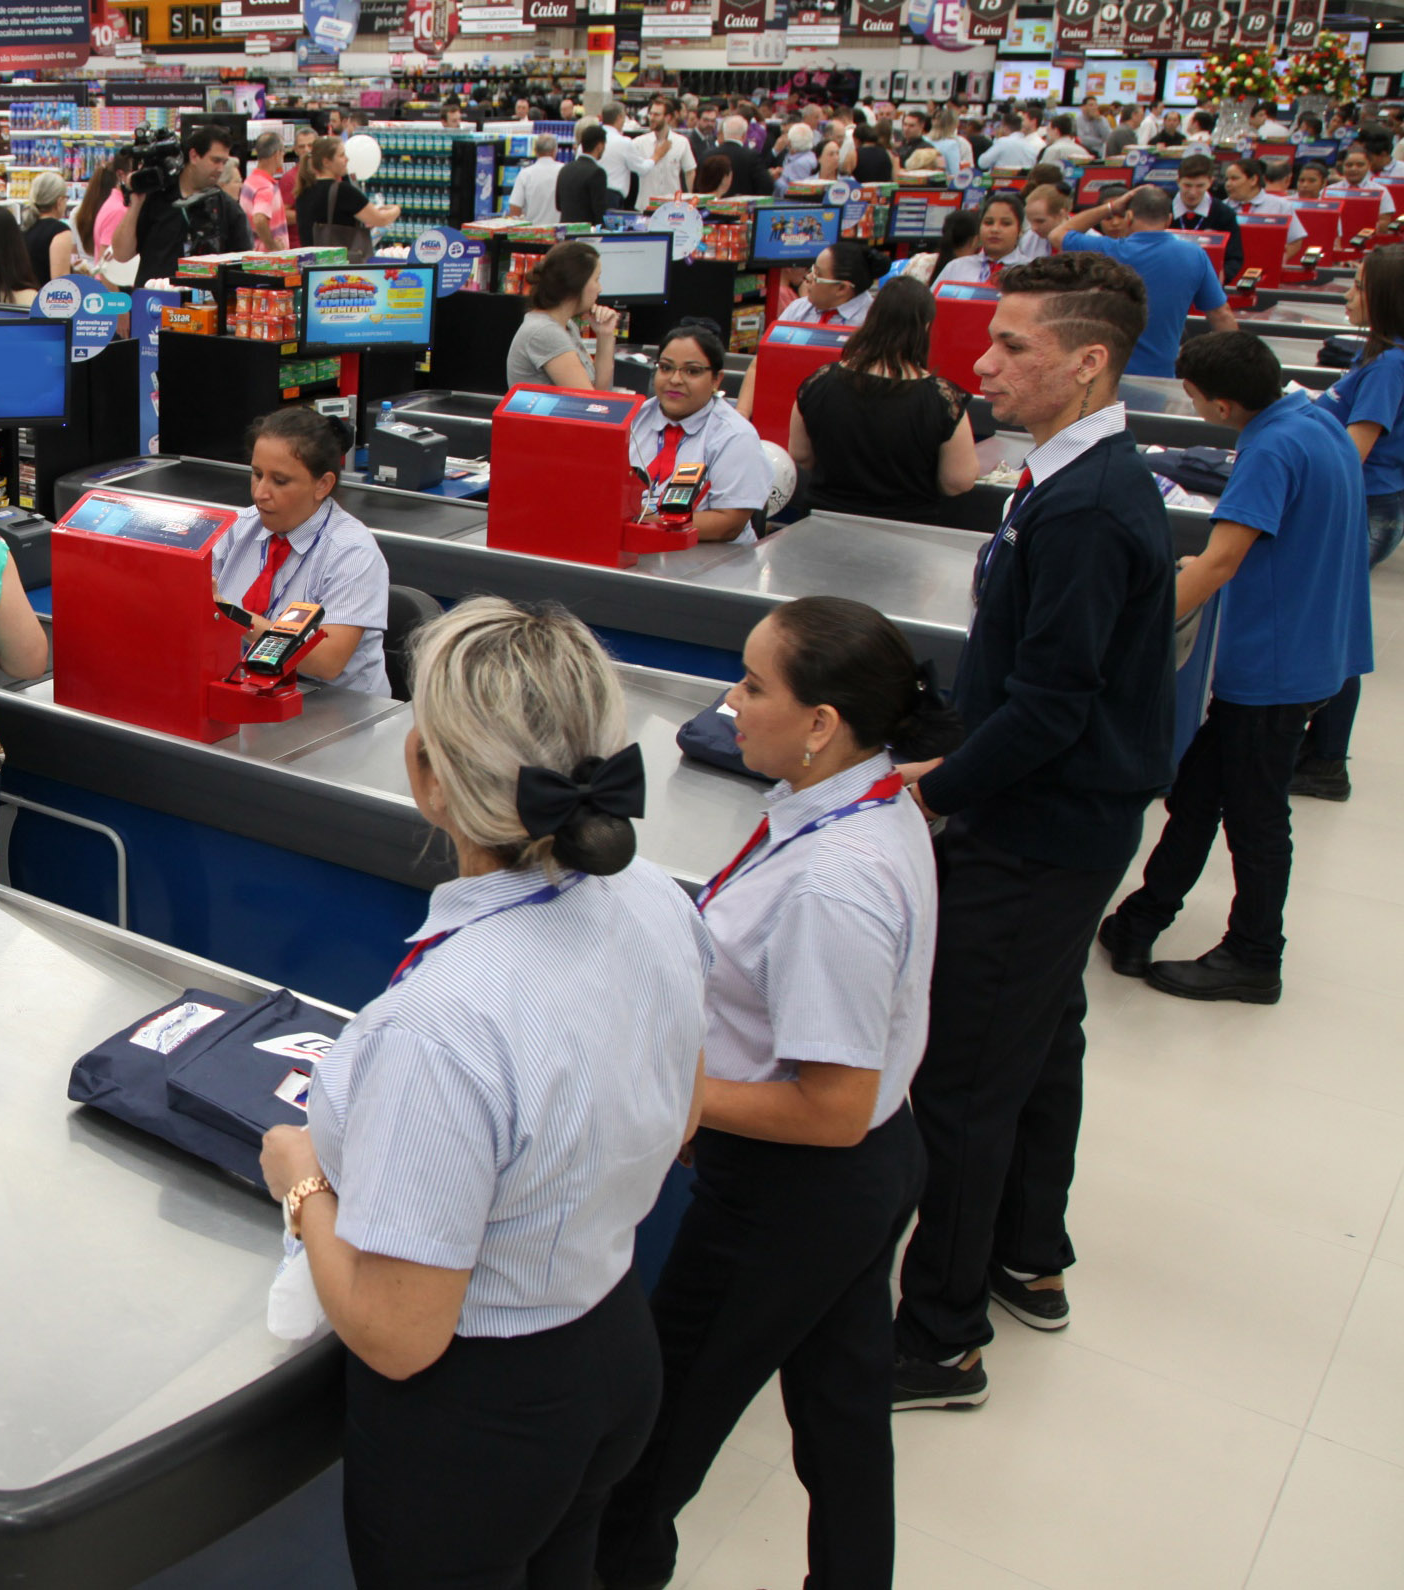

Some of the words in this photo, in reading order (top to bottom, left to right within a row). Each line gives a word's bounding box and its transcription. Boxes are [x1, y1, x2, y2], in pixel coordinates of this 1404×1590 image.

[530, 1, 568, 18] Caixa
[1066, 0, 1089, 15] 16
[1133, 4, 1156, 22] 17
[172, 14, 222, 34] Sho
[724, 14, 758, 28] Caixa
[862, 19, 894, 31] Caixa
[1190, 11, 1212, 28] 18
[1247, 15, 1266, 30] 19
[92, 25, 119, 47] 10x
[974, 24, 1002, 36] Caixa
[1061, 27, 1088, 39] Caixa
[1292, 22, 1314, 36] 20
[1129, 33, 1154, 43] Caixa
[1186, 38, 1209, 47] Caixa
[46, 291, 73, 300] MEGA
